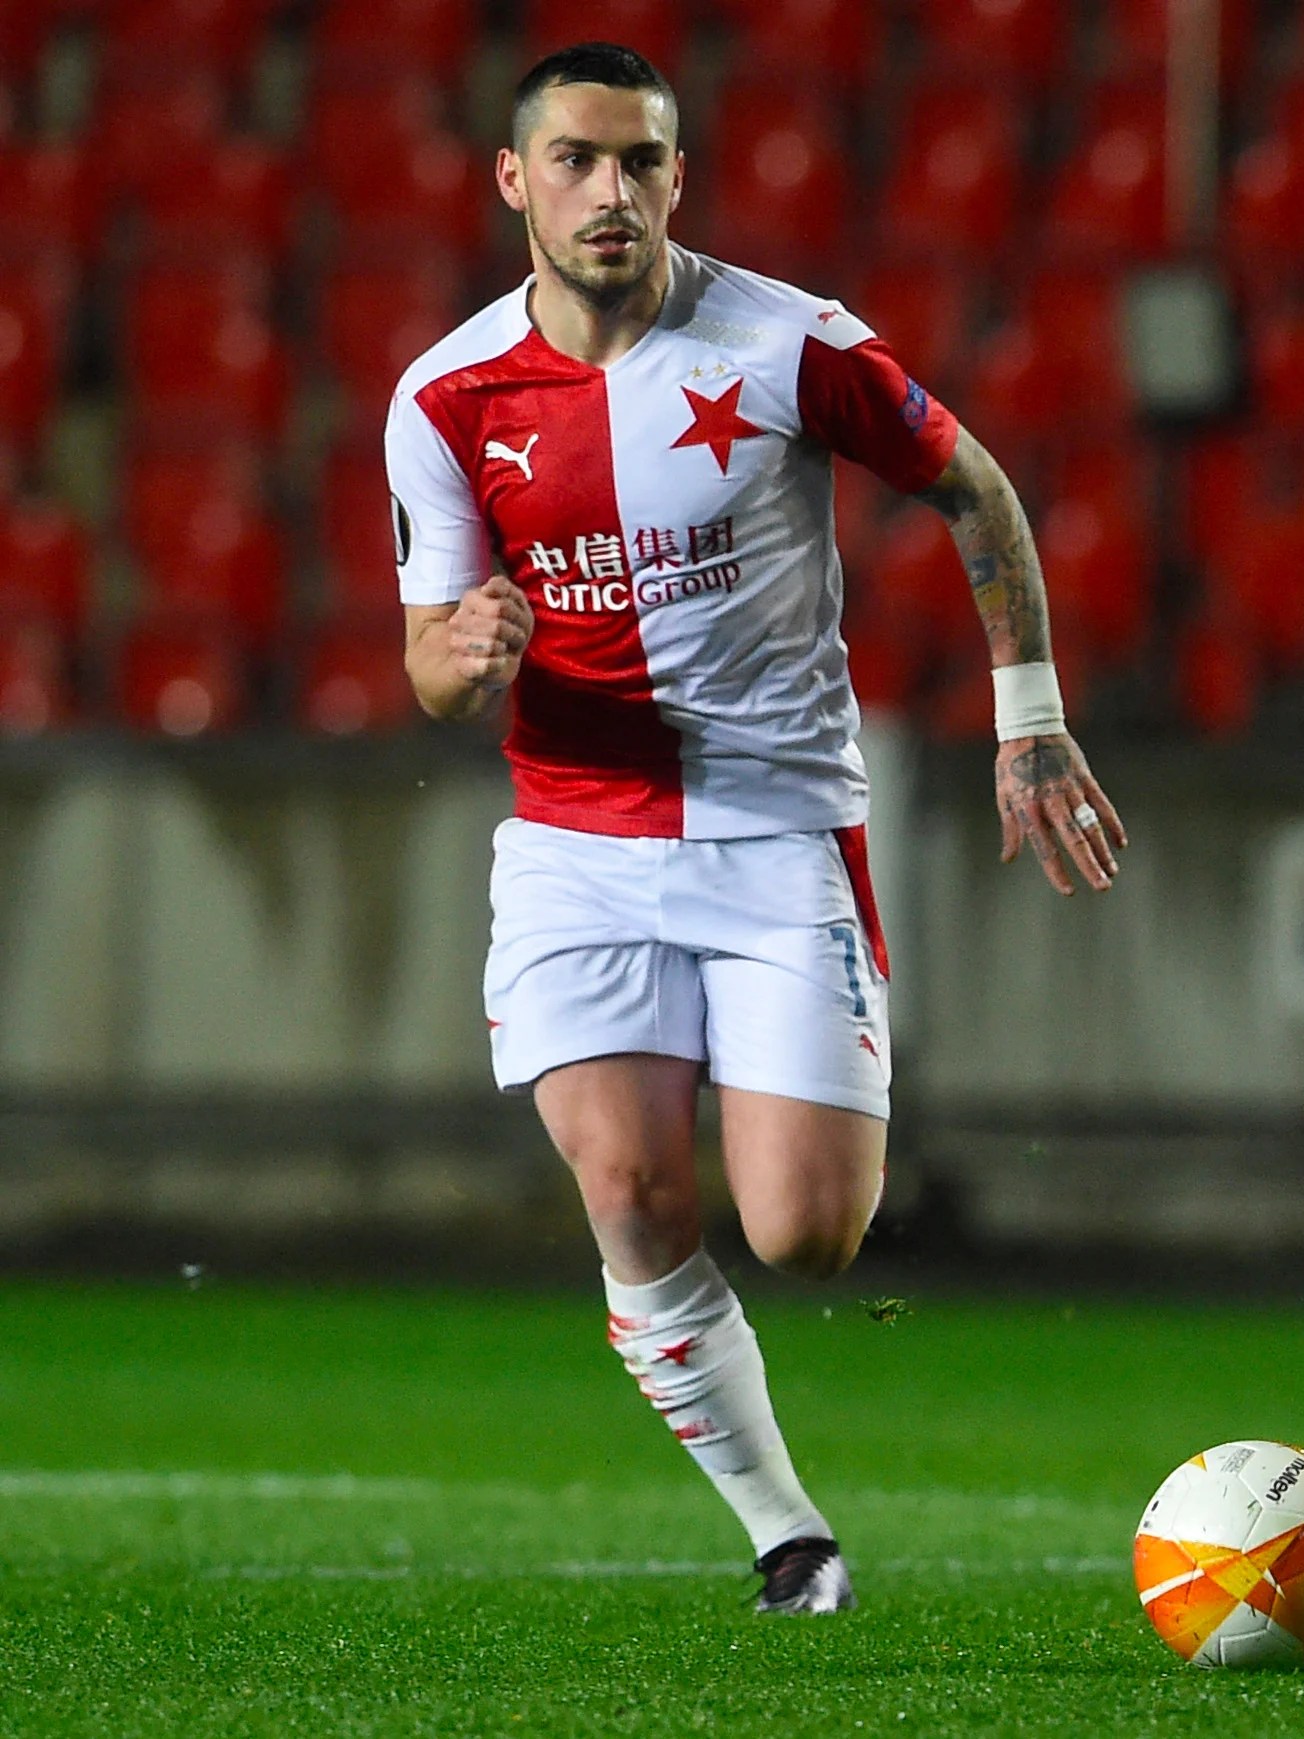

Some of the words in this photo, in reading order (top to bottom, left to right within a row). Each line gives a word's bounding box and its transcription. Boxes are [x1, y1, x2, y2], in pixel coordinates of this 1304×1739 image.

[527, 516, 734, 580] 中信集团
[543, 582, 630, 612] CITIC
[637, 562, 741, 607] Group
[829, 927, 867, 1017] 7
